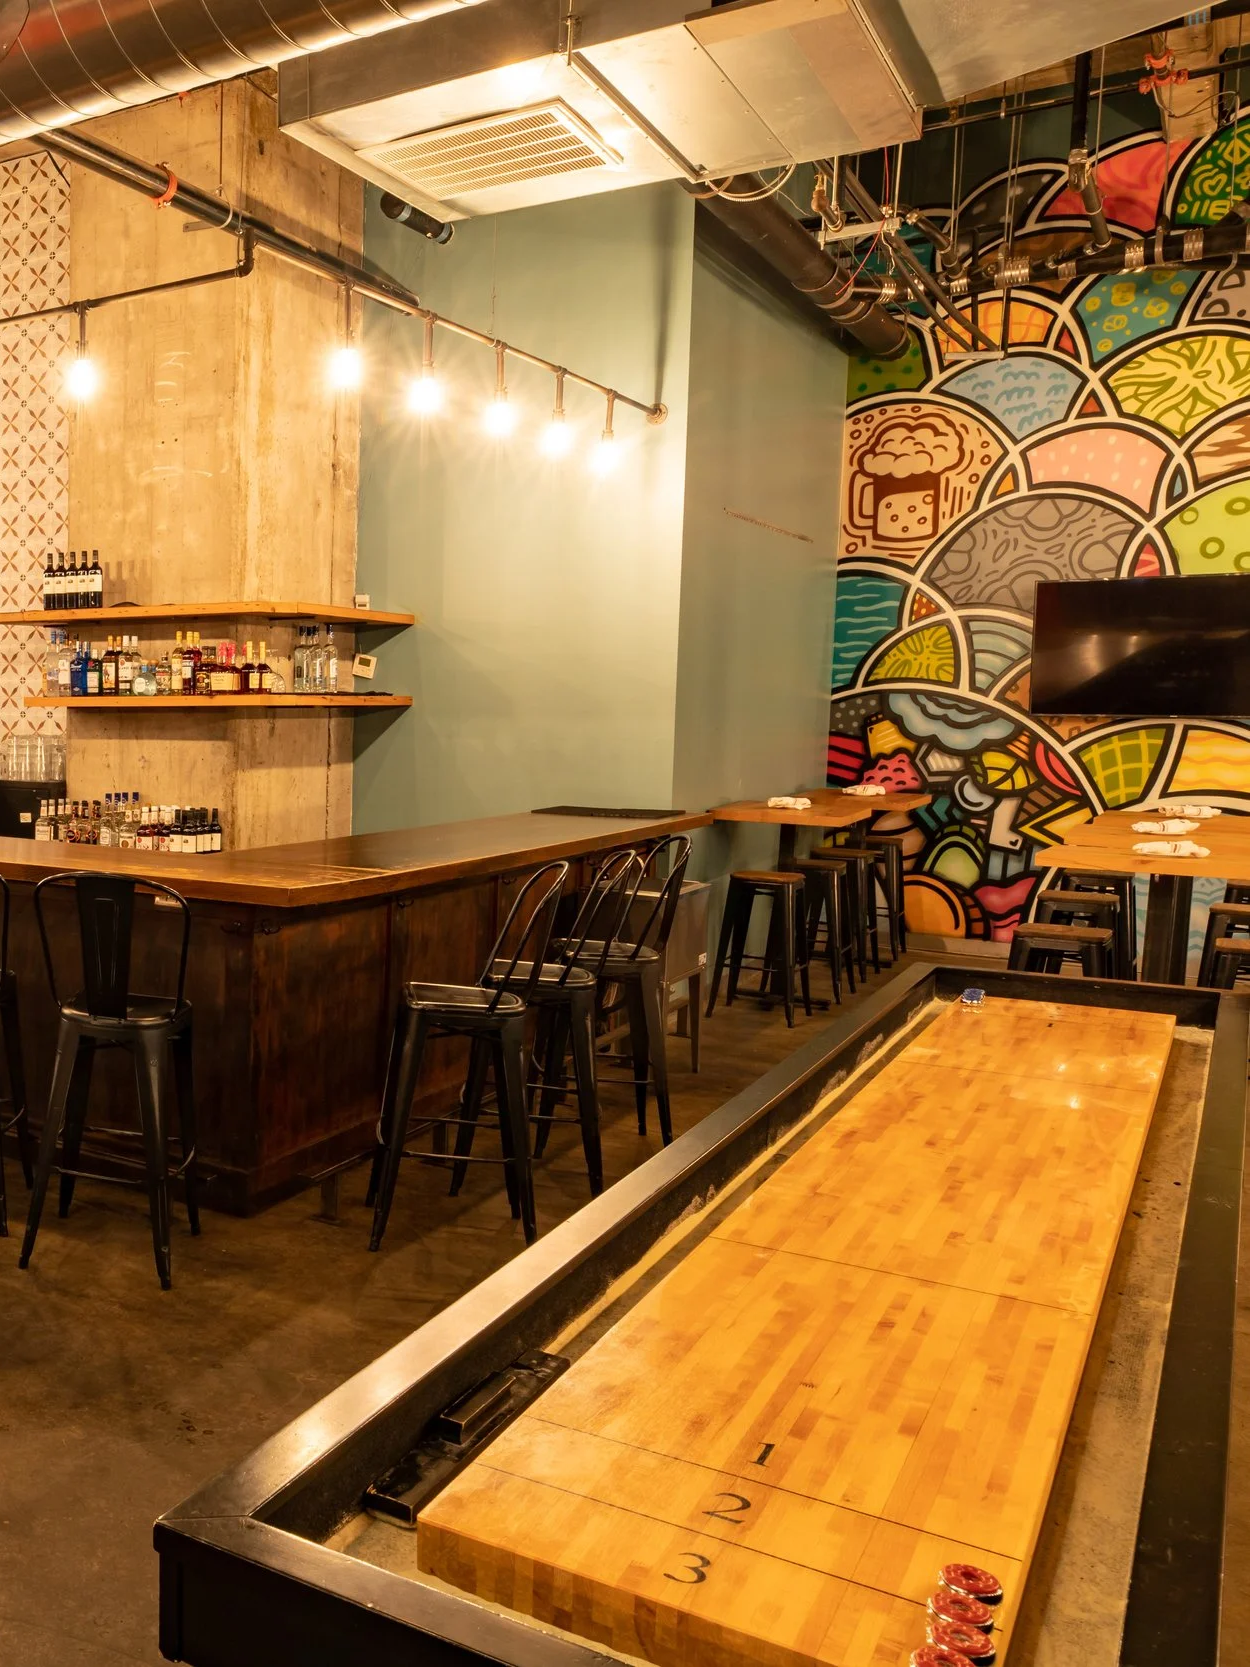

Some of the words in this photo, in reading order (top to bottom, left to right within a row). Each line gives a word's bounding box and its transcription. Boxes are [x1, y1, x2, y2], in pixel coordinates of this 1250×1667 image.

[748, 1442, 776, 1468] 1
[701, 1492, 752, 1524] 2
[663, 1552, 711, 1584] 3
